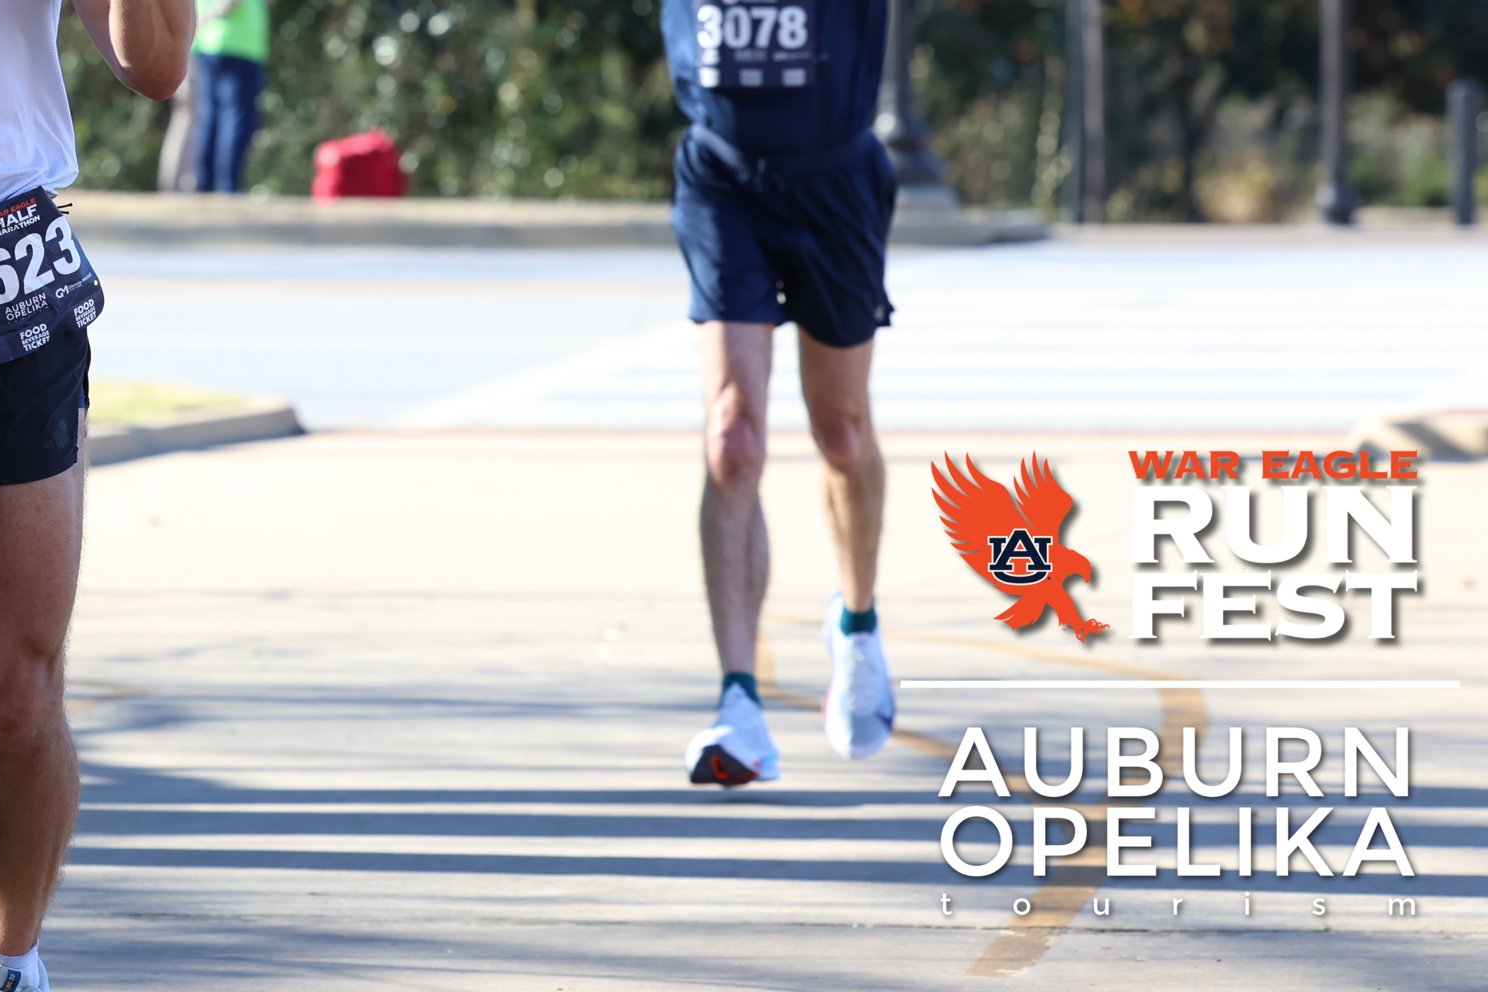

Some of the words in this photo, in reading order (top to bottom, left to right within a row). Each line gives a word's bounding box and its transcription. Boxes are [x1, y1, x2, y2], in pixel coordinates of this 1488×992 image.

[697, 5, 808, 49] 3078
[11, 197, 37, 212] EAGLE
[5, 292, 47, 314] AUBURN
[6, 300, 48, 321] OPELIKA
[74, 299, 95, 316] FOOD
[77, 311, 97, 328] TICKET
[19, 323, 47, 340] FOOD
[23, 336, 50, 351] TICKET
